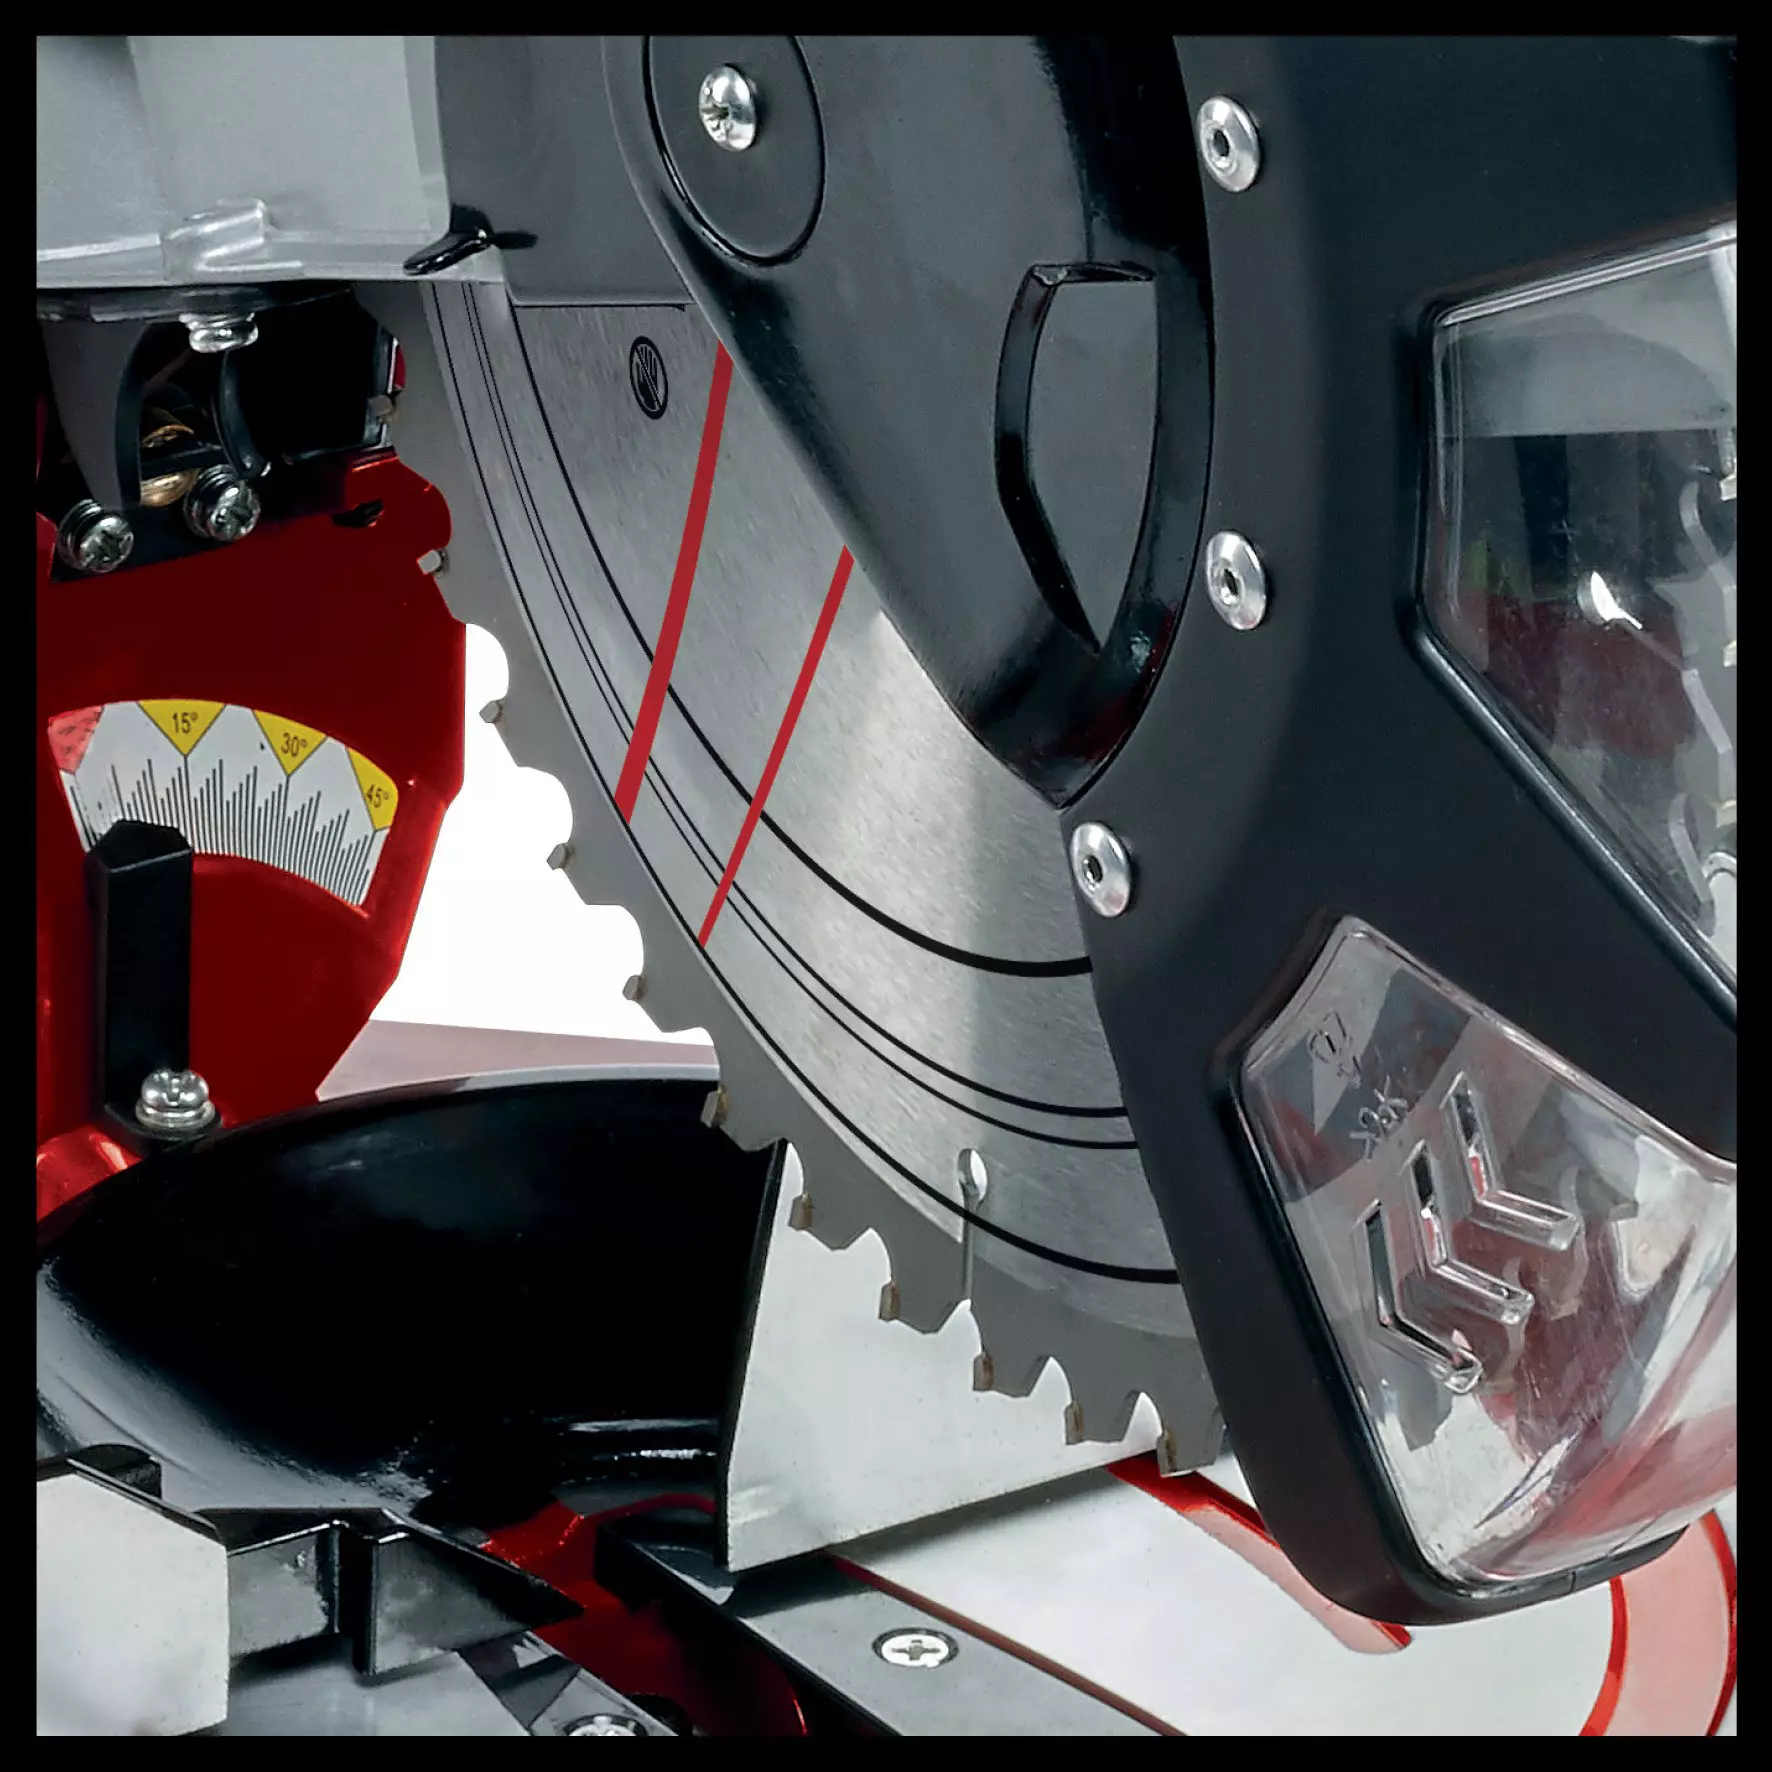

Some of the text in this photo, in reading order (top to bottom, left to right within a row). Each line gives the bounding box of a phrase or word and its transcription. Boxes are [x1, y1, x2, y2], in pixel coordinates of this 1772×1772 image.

[172, 711, 199, 734] 15°
[280, 732, 308, 757] 30°
[365, 783, 390, 809] 45°
